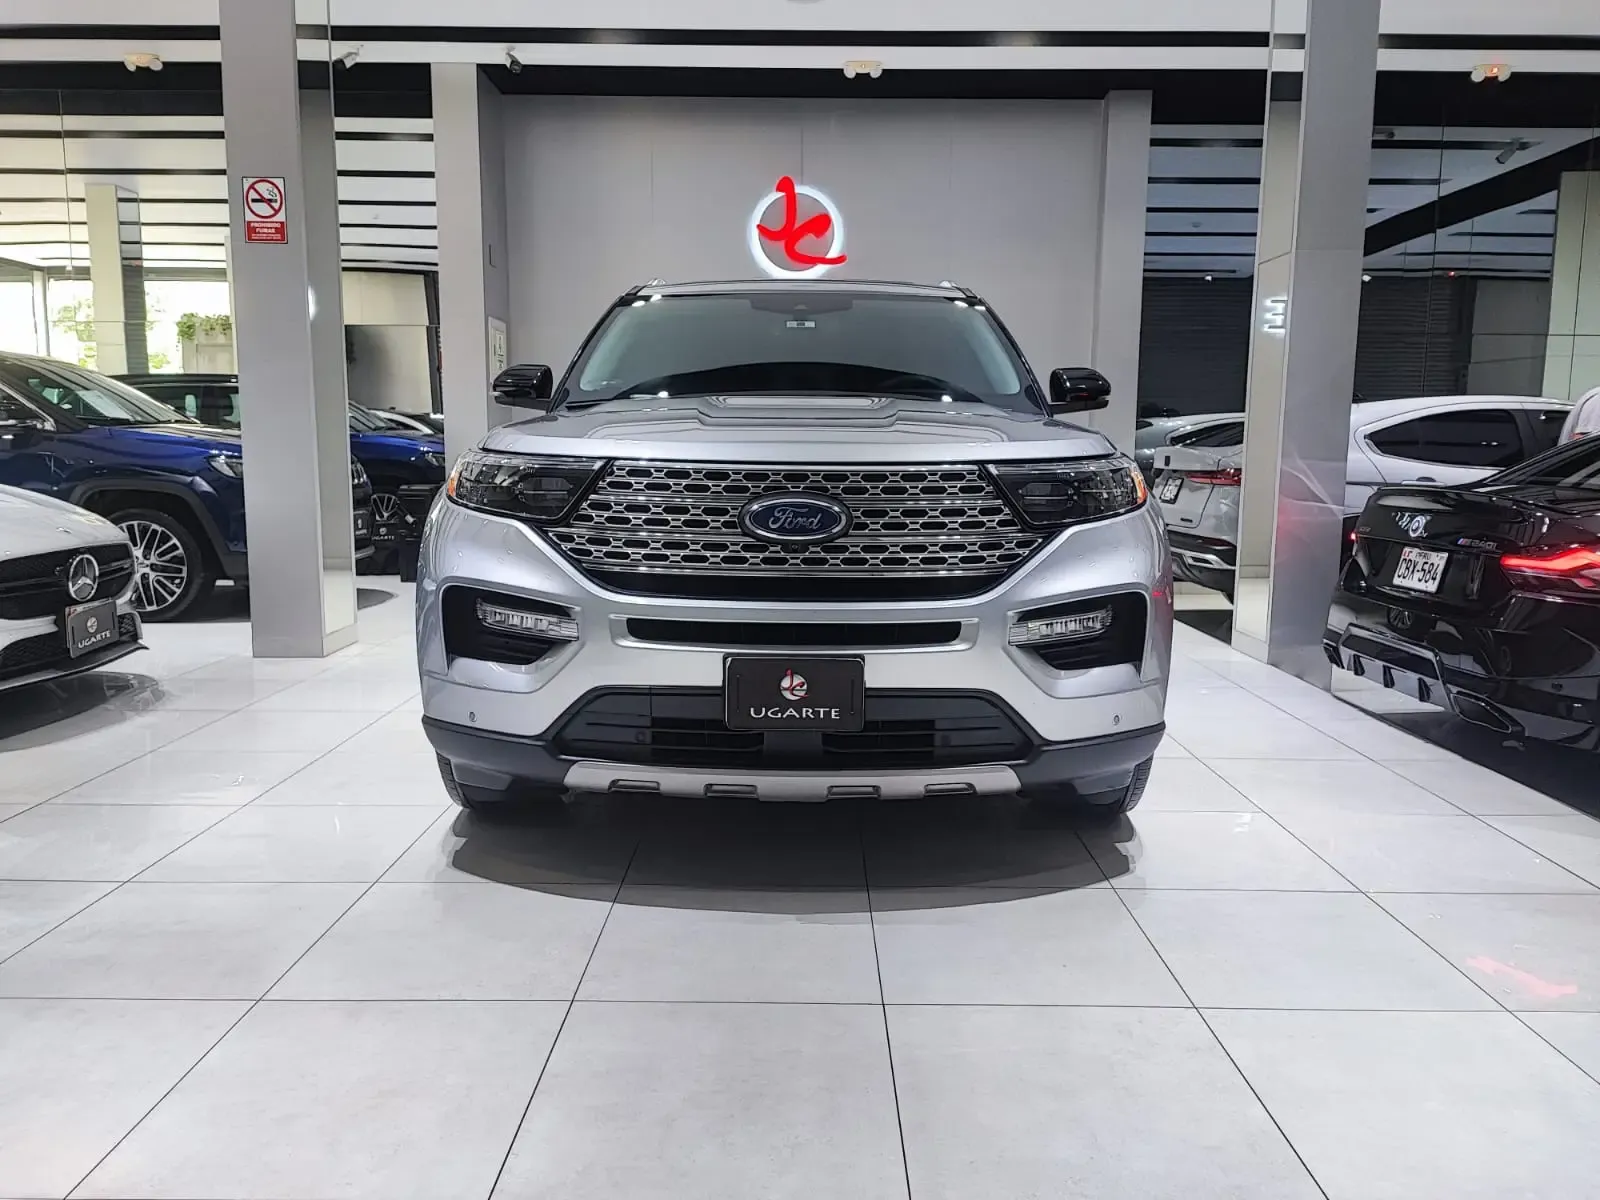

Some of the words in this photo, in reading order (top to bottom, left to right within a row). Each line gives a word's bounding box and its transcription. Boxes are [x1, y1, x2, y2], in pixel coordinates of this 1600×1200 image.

[768, 506, 822, 529] Ford
[1397, 558, 1440, 584] CBX-584
[78, 630, 111, 648] UGARTE
[750, 707, 840, 719] UGARTE
